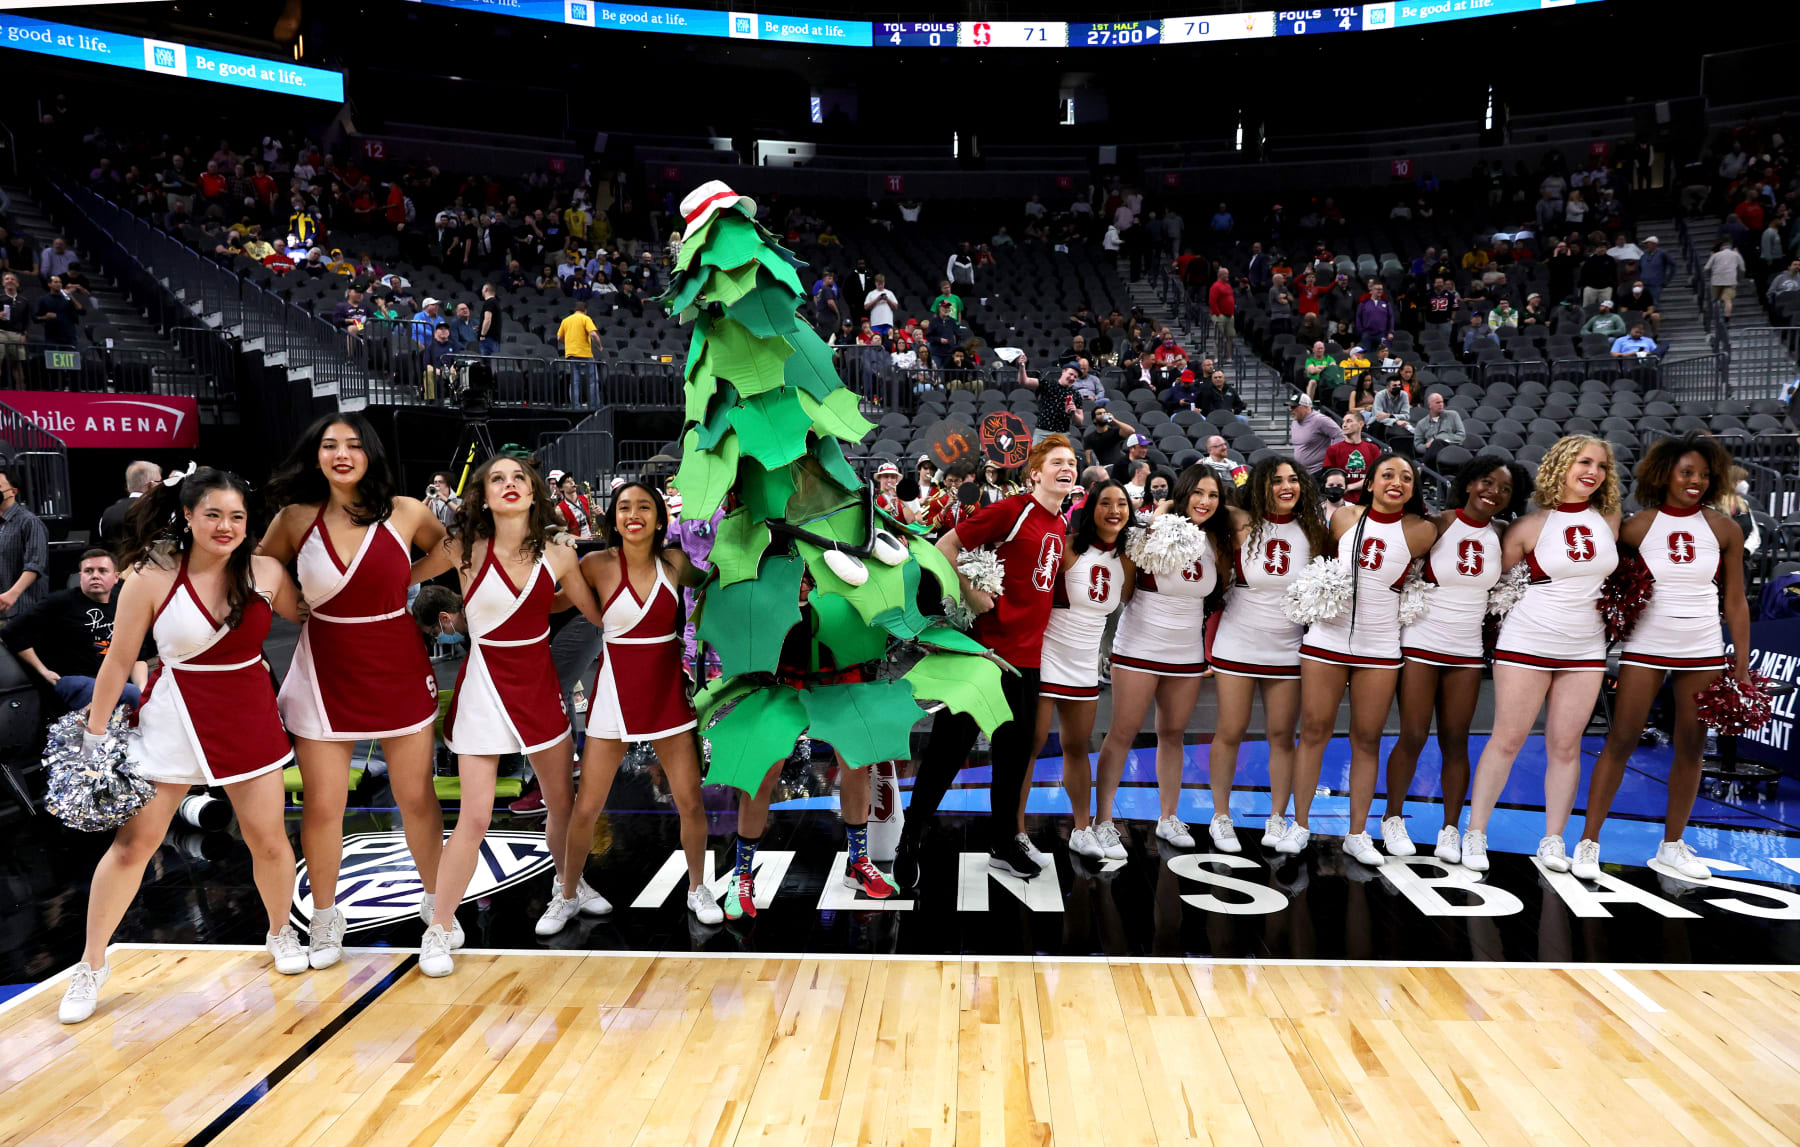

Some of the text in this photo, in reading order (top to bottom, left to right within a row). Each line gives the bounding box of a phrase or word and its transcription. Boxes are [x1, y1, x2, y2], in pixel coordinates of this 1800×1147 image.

[1279, 8, 1358, 21] FOULS TOL
[1401, 7, 1417, 18] Be
[1420, 1, 1451, 18] good
[1453, 1, 1466, 11] at
[602, 9, 687, 26] Be good at life.
[1339, 17, 1351, 30] 4
[765, 21, 846, 37] Be good at life.
[884, 24, 954, 32] TOL FOULS
[1114, 22, 1139, 30] HALF
[1184, 22, 1210, 36] 70
[1294, 20, 1306, 34] 0
[8, 26, 52, 43] good
[57, 35, 75, 47] at
[78, 34, 111, 53] life.
[890, 32, 902, 45] 4
[929, 33, 940, 46] 0
[1024, 28, 1048, 41] 71
[1087, 30, 1143, 45] 27:00
[196, 56, 306, 87] Be good at life.
[365, 143, 383, 158] 12
[1396, 162, 1409, 176] 10
[53, 353, 75, 367] EXIT
[85, 417, 167, 432] ARENA
[1760, 651, 1800, 685] MEN'
[1377, 855, 1800, 920] BAS
